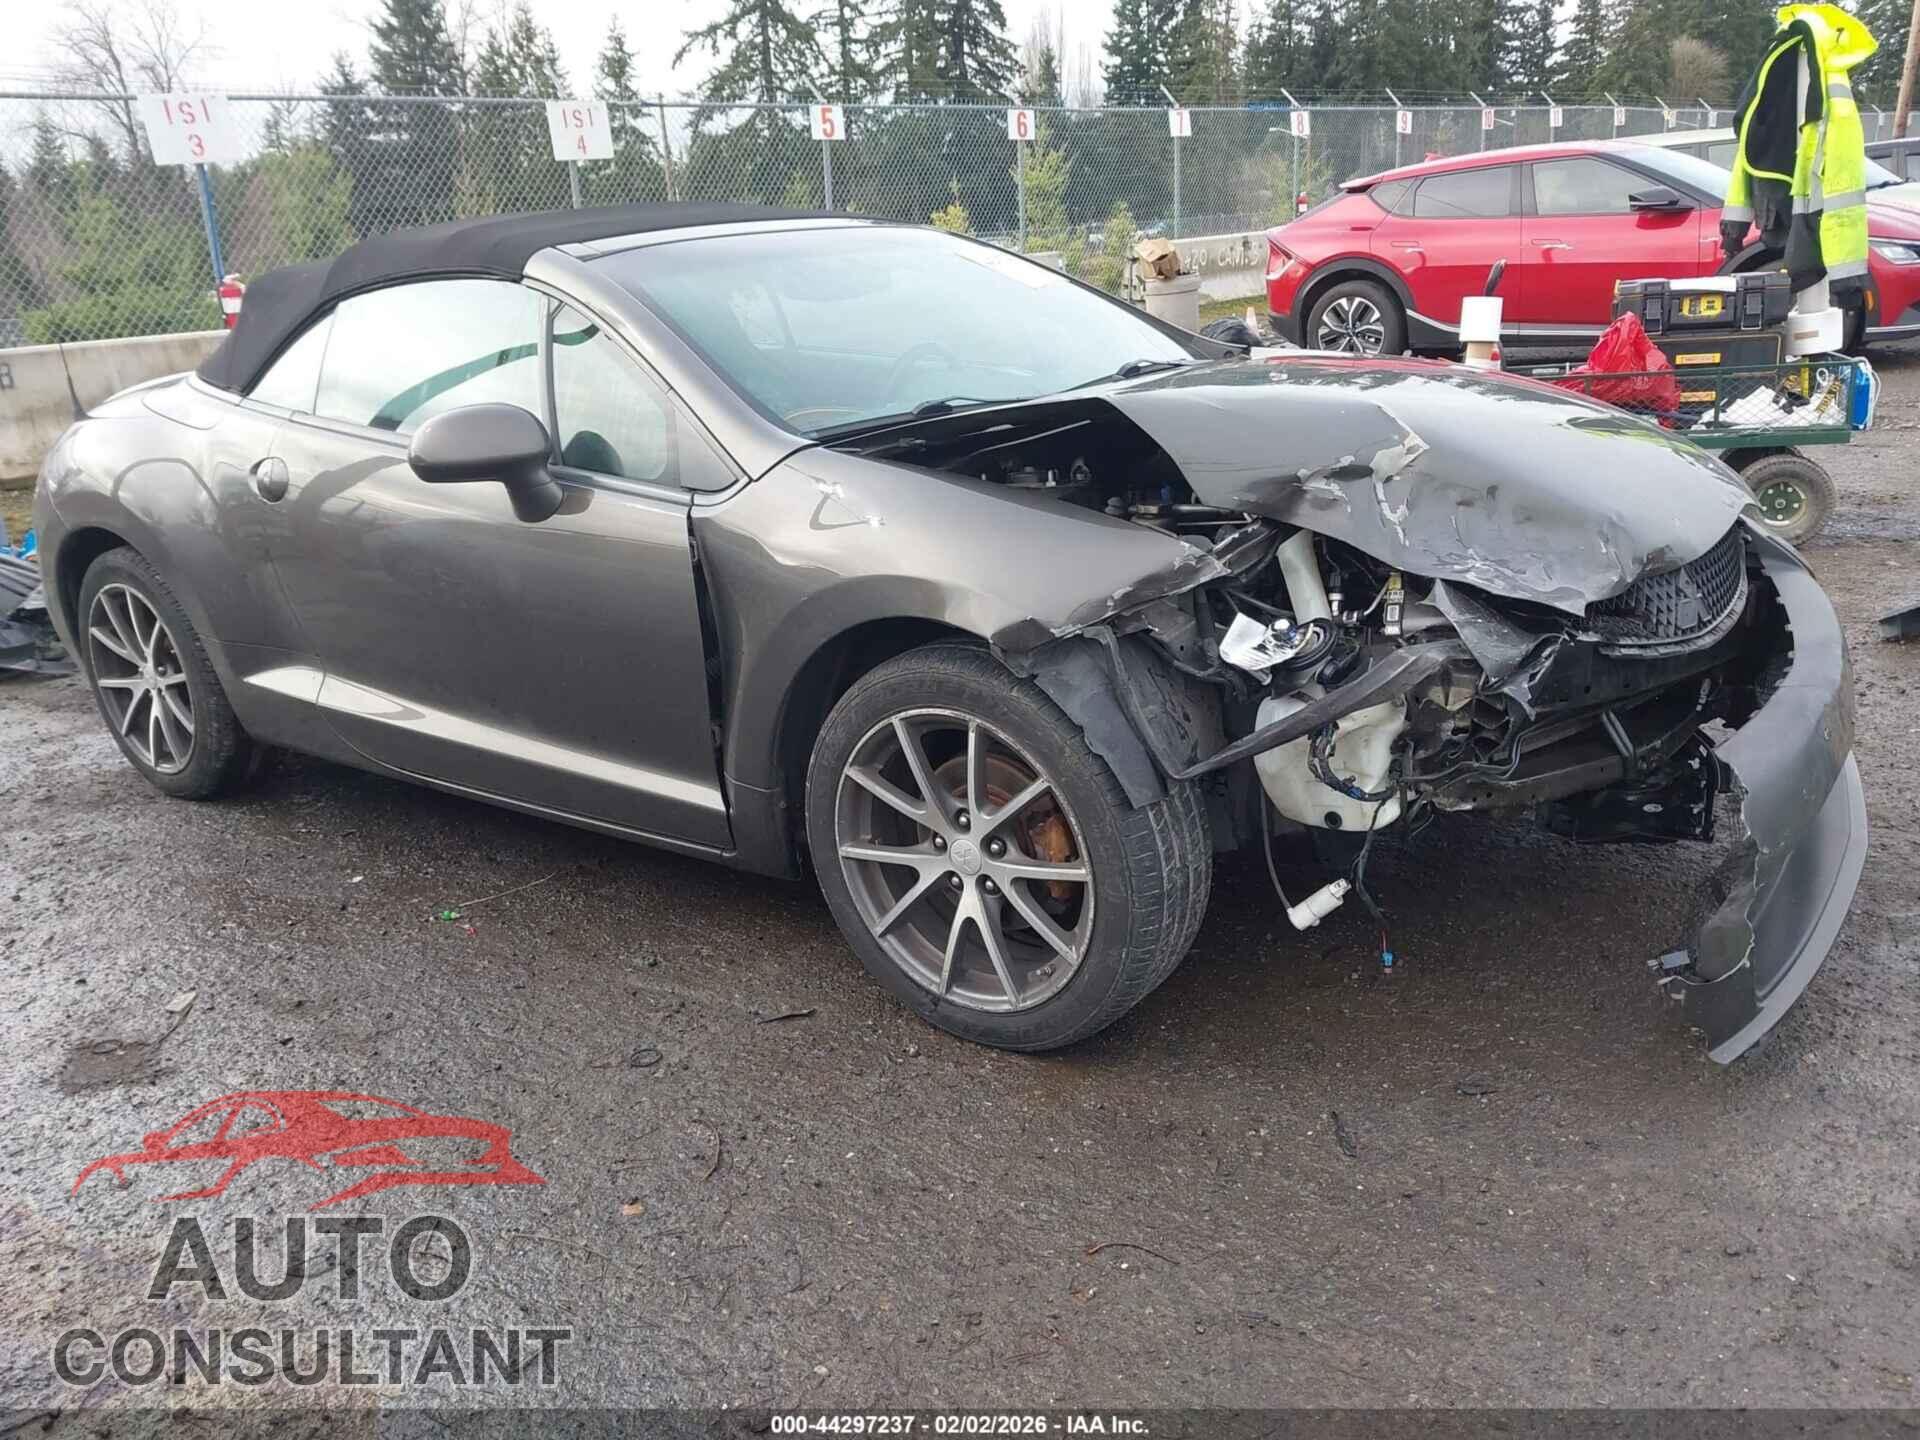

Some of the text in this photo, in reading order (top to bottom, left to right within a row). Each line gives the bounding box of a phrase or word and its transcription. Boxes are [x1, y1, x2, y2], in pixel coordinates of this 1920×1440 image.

[820, 107, 835, 138] 5
[1017, 111, 1028, 138] 6
[1176, 111, 1184, 135] 7
[1296, 112, 1304, 134] 8
[1400, 112, 1408, 131] 9
[1484, 110, 1493, 128] 10
[187, 134, 205, 156] 3
[577, 136, 587, 155] 4
